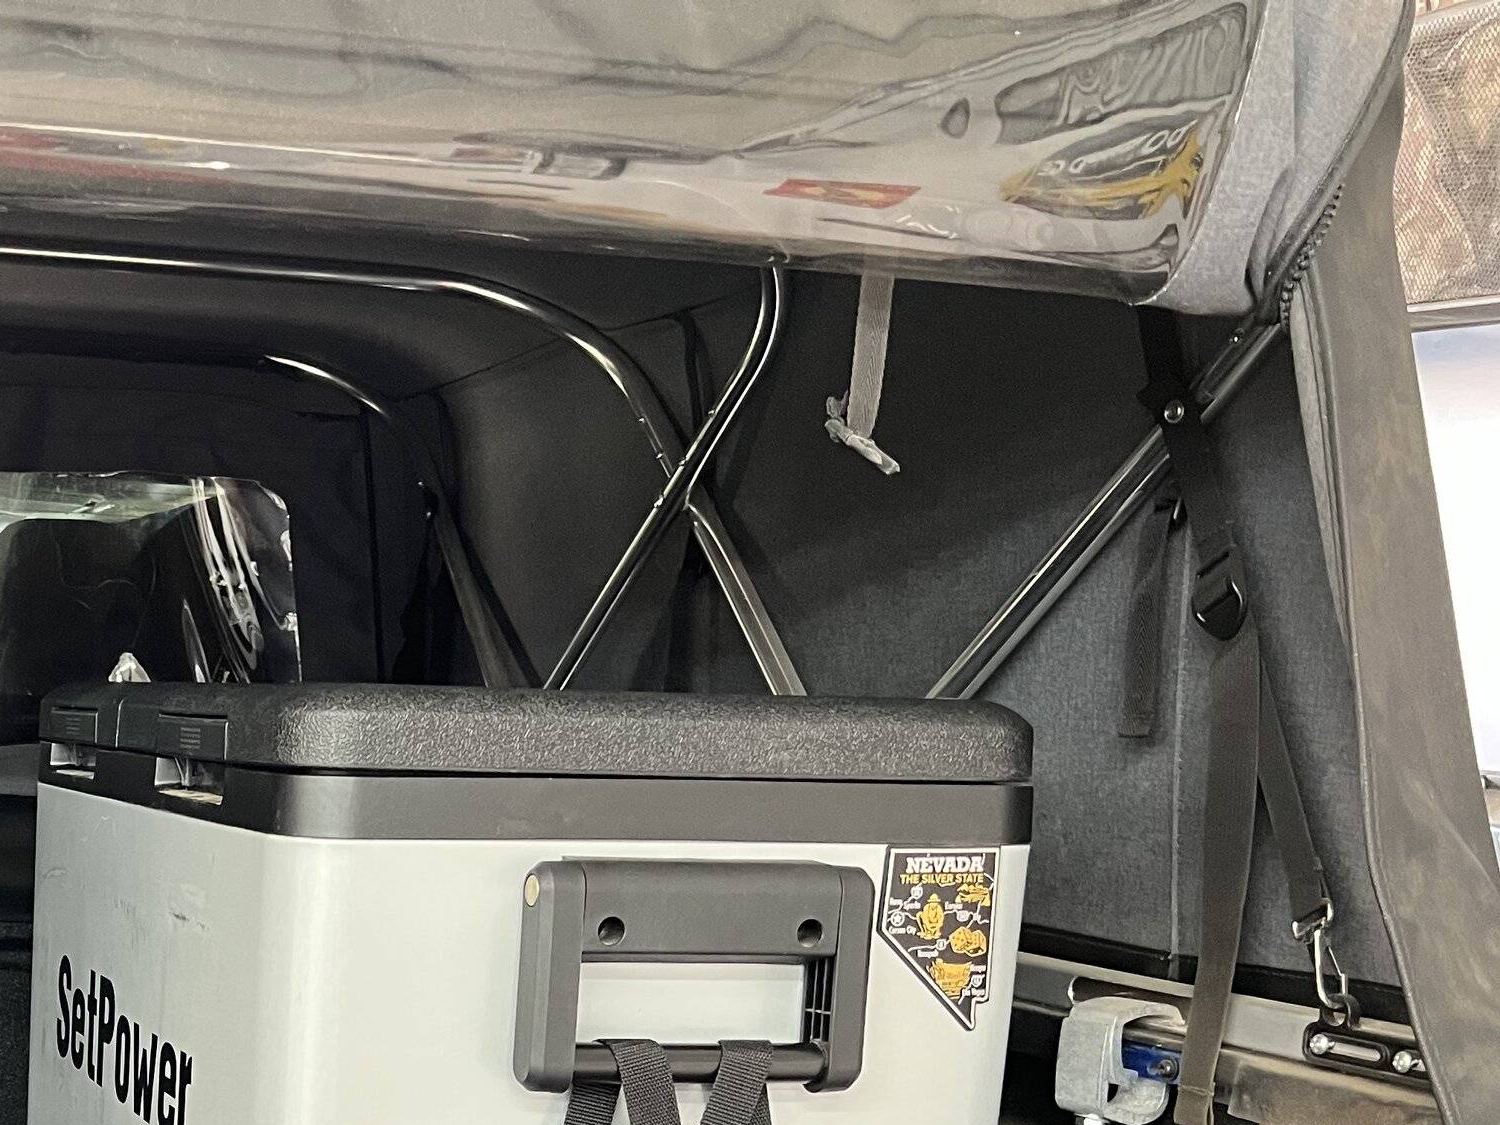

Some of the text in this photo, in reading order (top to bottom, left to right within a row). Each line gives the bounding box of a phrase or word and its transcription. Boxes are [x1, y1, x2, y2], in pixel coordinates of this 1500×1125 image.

[905, 856, 984, 874] NEVADA
[899, 872, 984, 884] THE SILVER STATE
